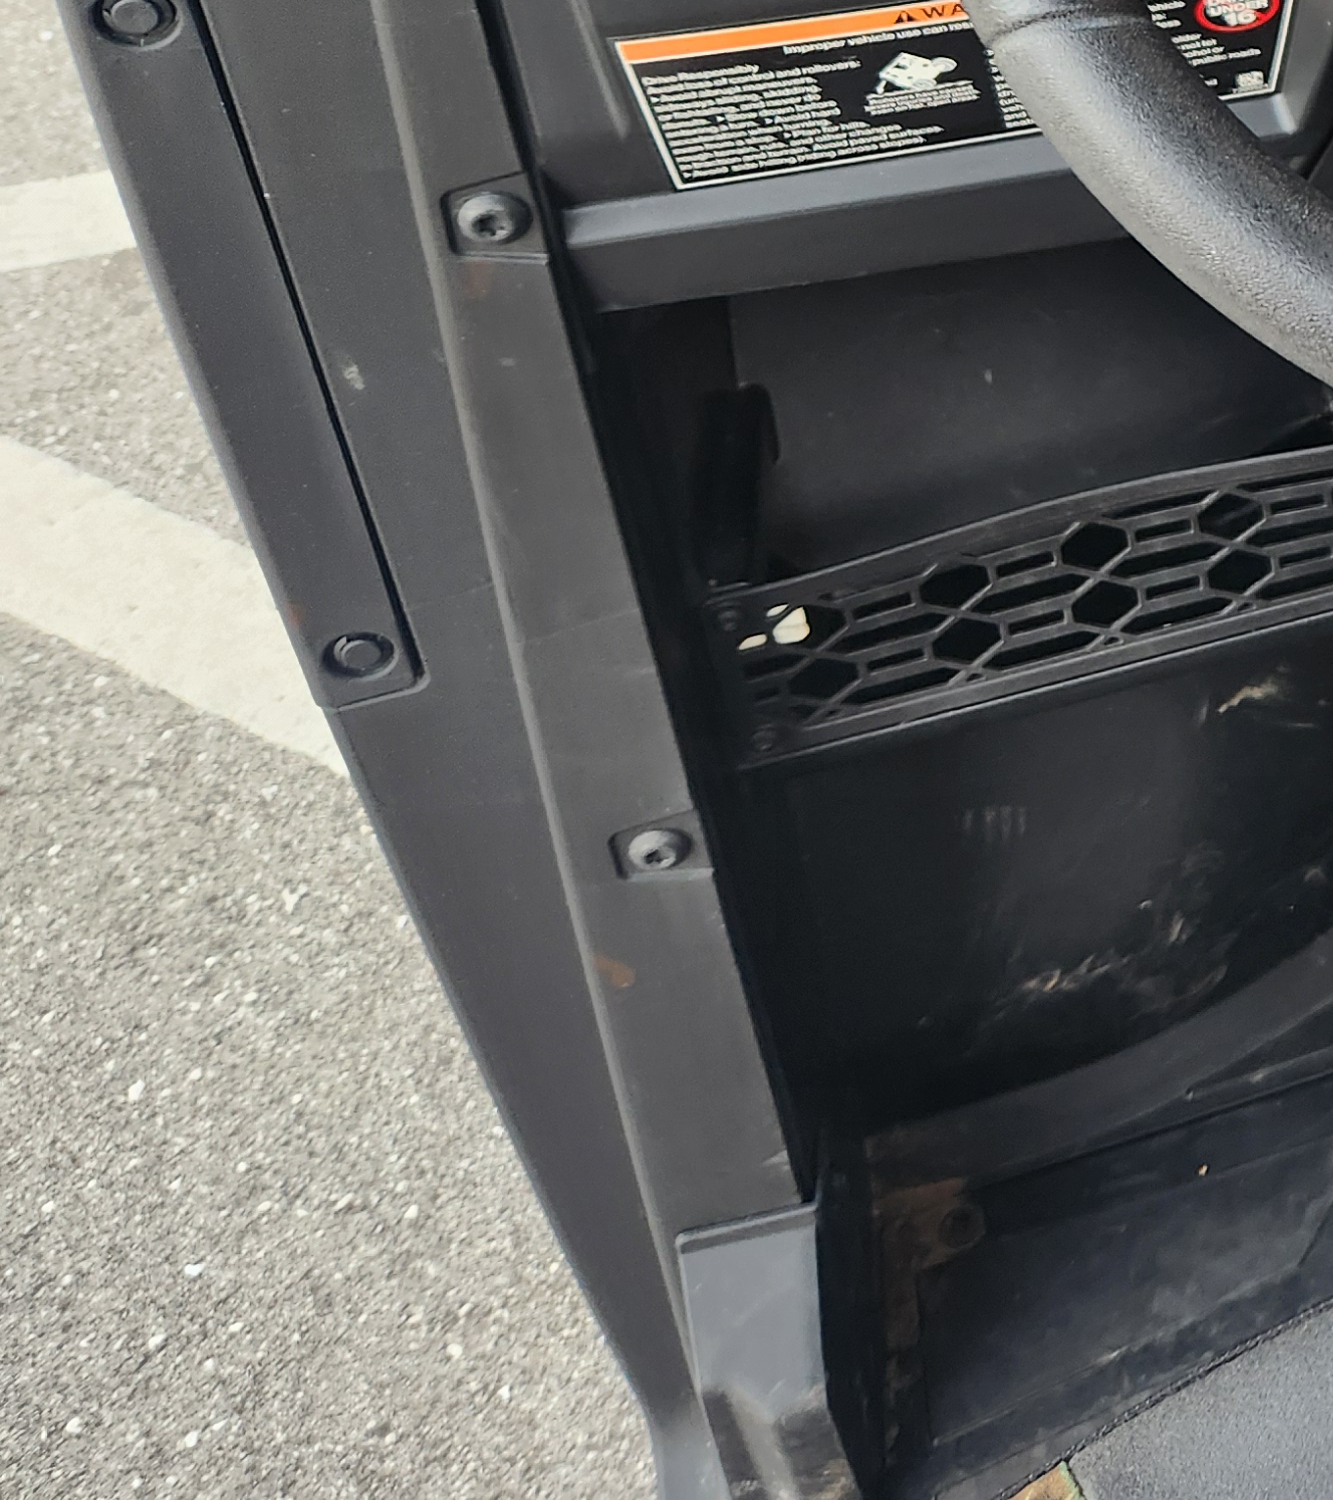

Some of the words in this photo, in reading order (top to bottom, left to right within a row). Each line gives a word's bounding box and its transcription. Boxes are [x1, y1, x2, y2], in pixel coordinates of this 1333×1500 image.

[1147, 0, 1186, 12] ehicle
[1224, 8, 1257, 27] 16
[783, 39, 846, 56] Improper
[847, 32, 896, 46] vehicle
[896, 29, 922, 39] use
[922, 26, 949, 35] can
[776, 67, 801, 78] and
